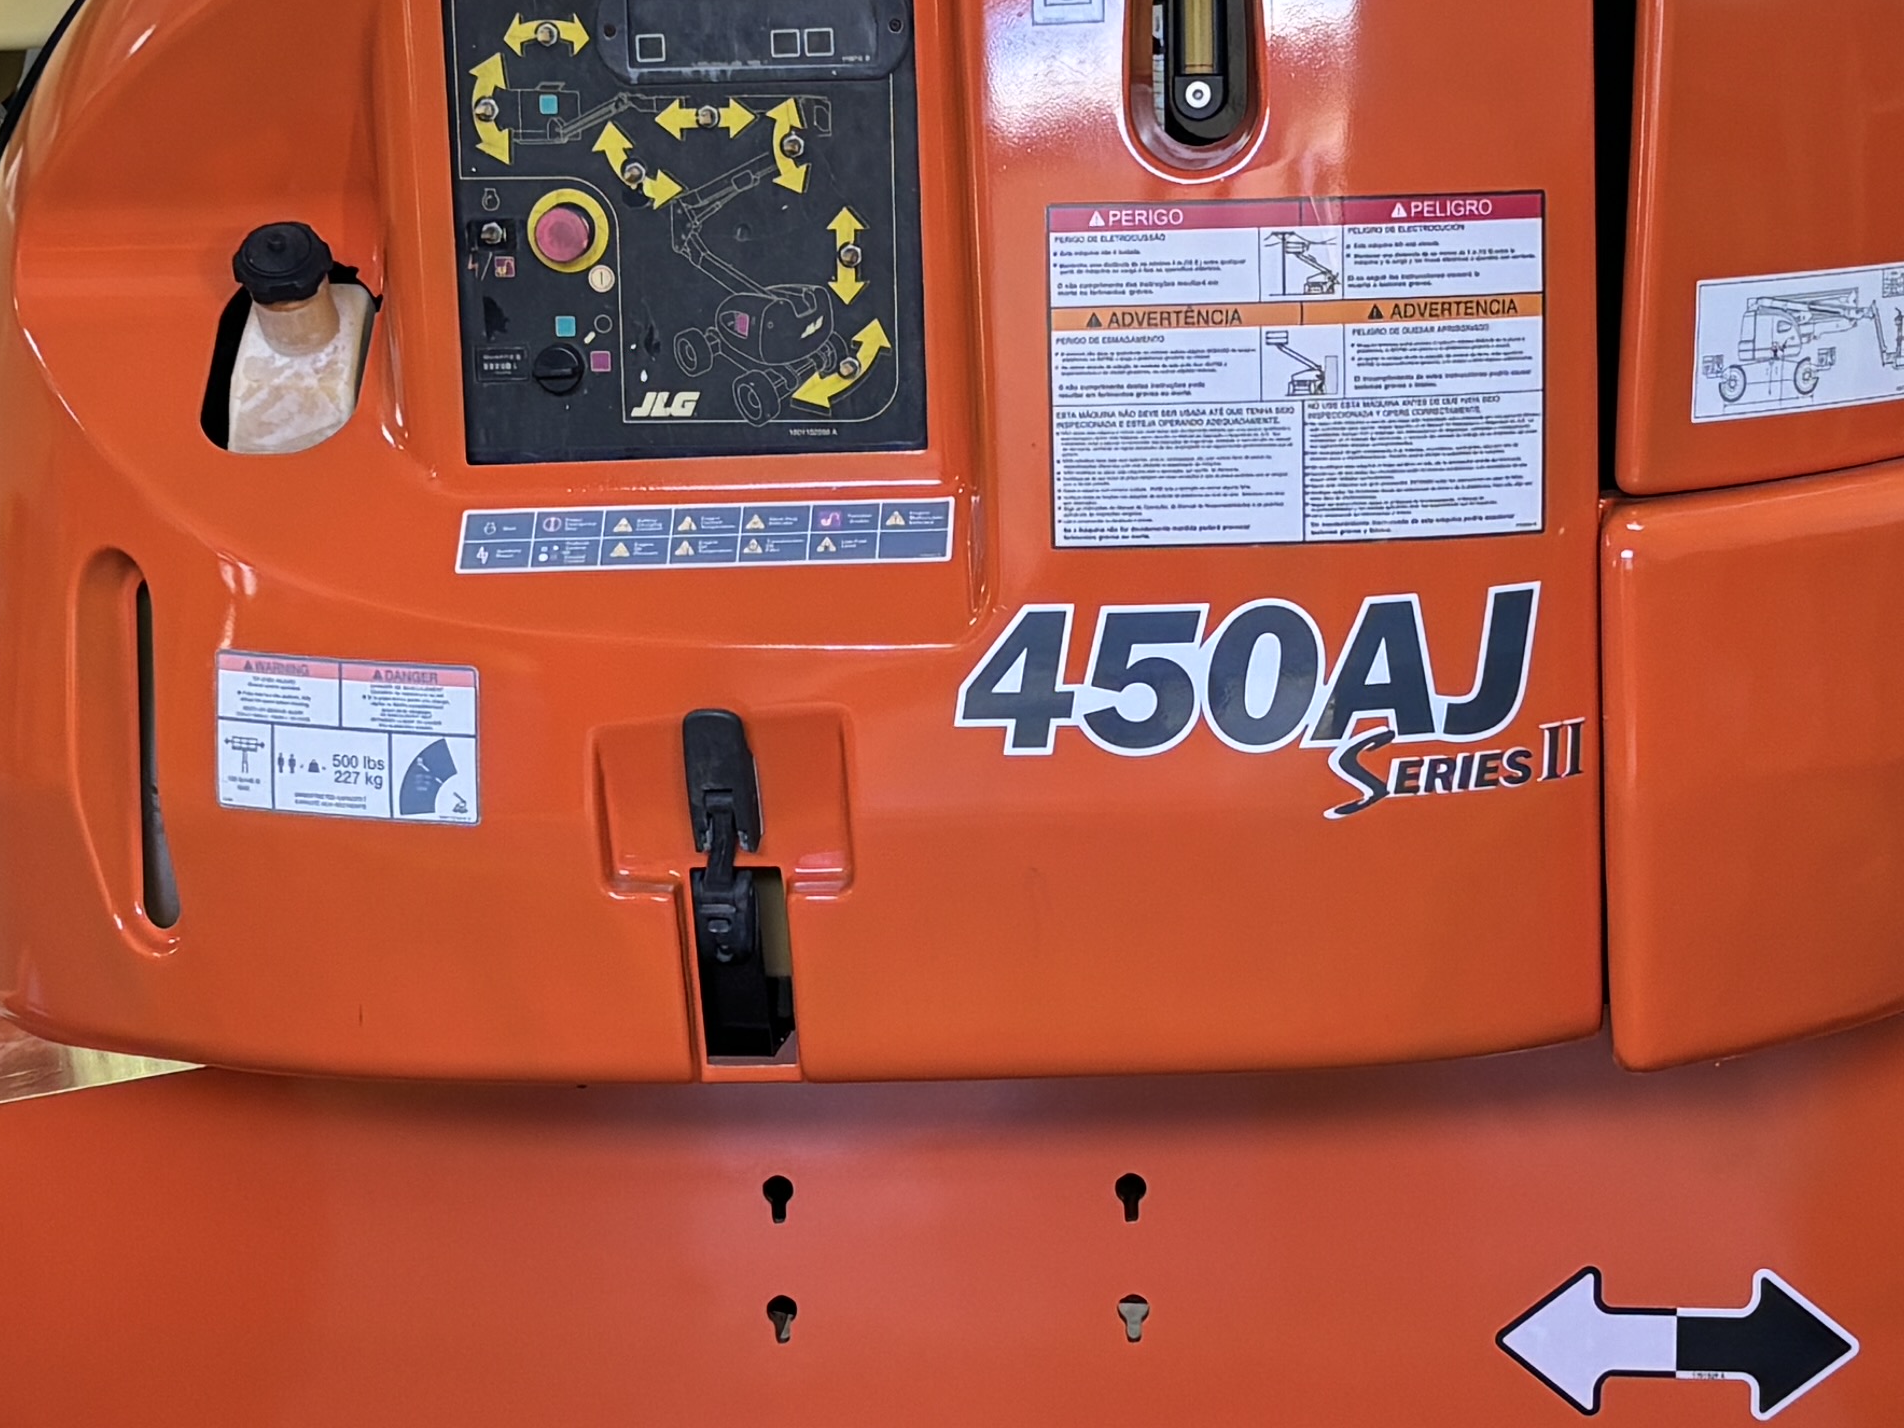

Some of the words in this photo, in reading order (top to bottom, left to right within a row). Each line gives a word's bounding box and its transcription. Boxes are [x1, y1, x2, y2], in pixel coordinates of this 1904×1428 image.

[1108, 208, 1184, 227] PERIGO
[1410, 199, 1492, 217] PELIGRO
[1107, 305, 1243, 328] ADVERTÊNCIA
[1390, 298, 1518, 319] ADVERTENCIA
[630, 391, 701, 417] JLG
[253, 659, 310, 677] WARNING
[384, 669, 438, 684] DANGER
[955, 580, 1541, 756] 450AJ
[1539, 718, 1585, 782] II
[332, 754, 359, 770] 500
[363, 755, 385, 771] lbs
[334, 771, 360, 785] 227
[365, 773, 384, 790] kg
